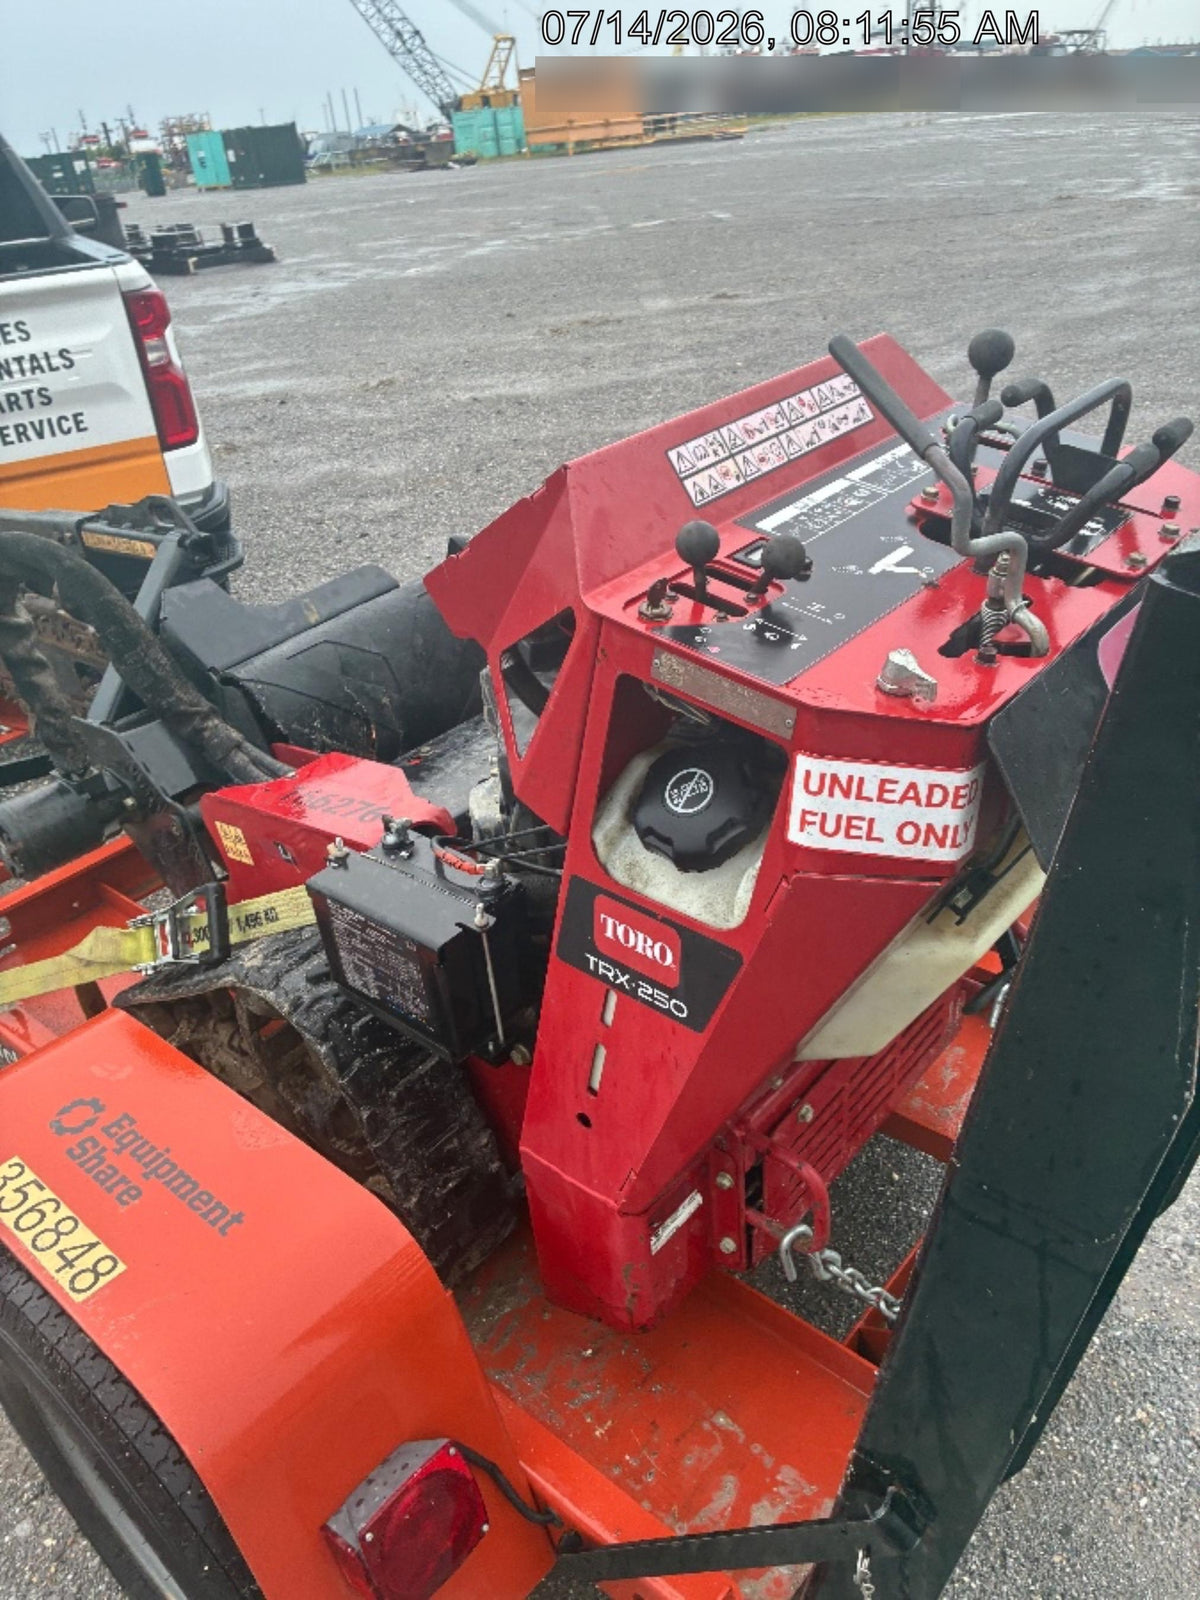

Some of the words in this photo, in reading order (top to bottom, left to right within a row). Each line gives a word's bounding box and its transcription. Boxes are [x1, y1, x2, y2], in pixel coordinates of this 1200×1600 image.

[803, 770, 979, 810] UNLEADED
[799, 808, 884, 843] FUEL
[896, 815, 974, 849] ONLY
[600, 913, 674, 967] TORO
[66, 1135, 144, 1207] Share
[101, 1112, 245, 1237] Equipment
[0, 1162, 119, 1294] 356848
